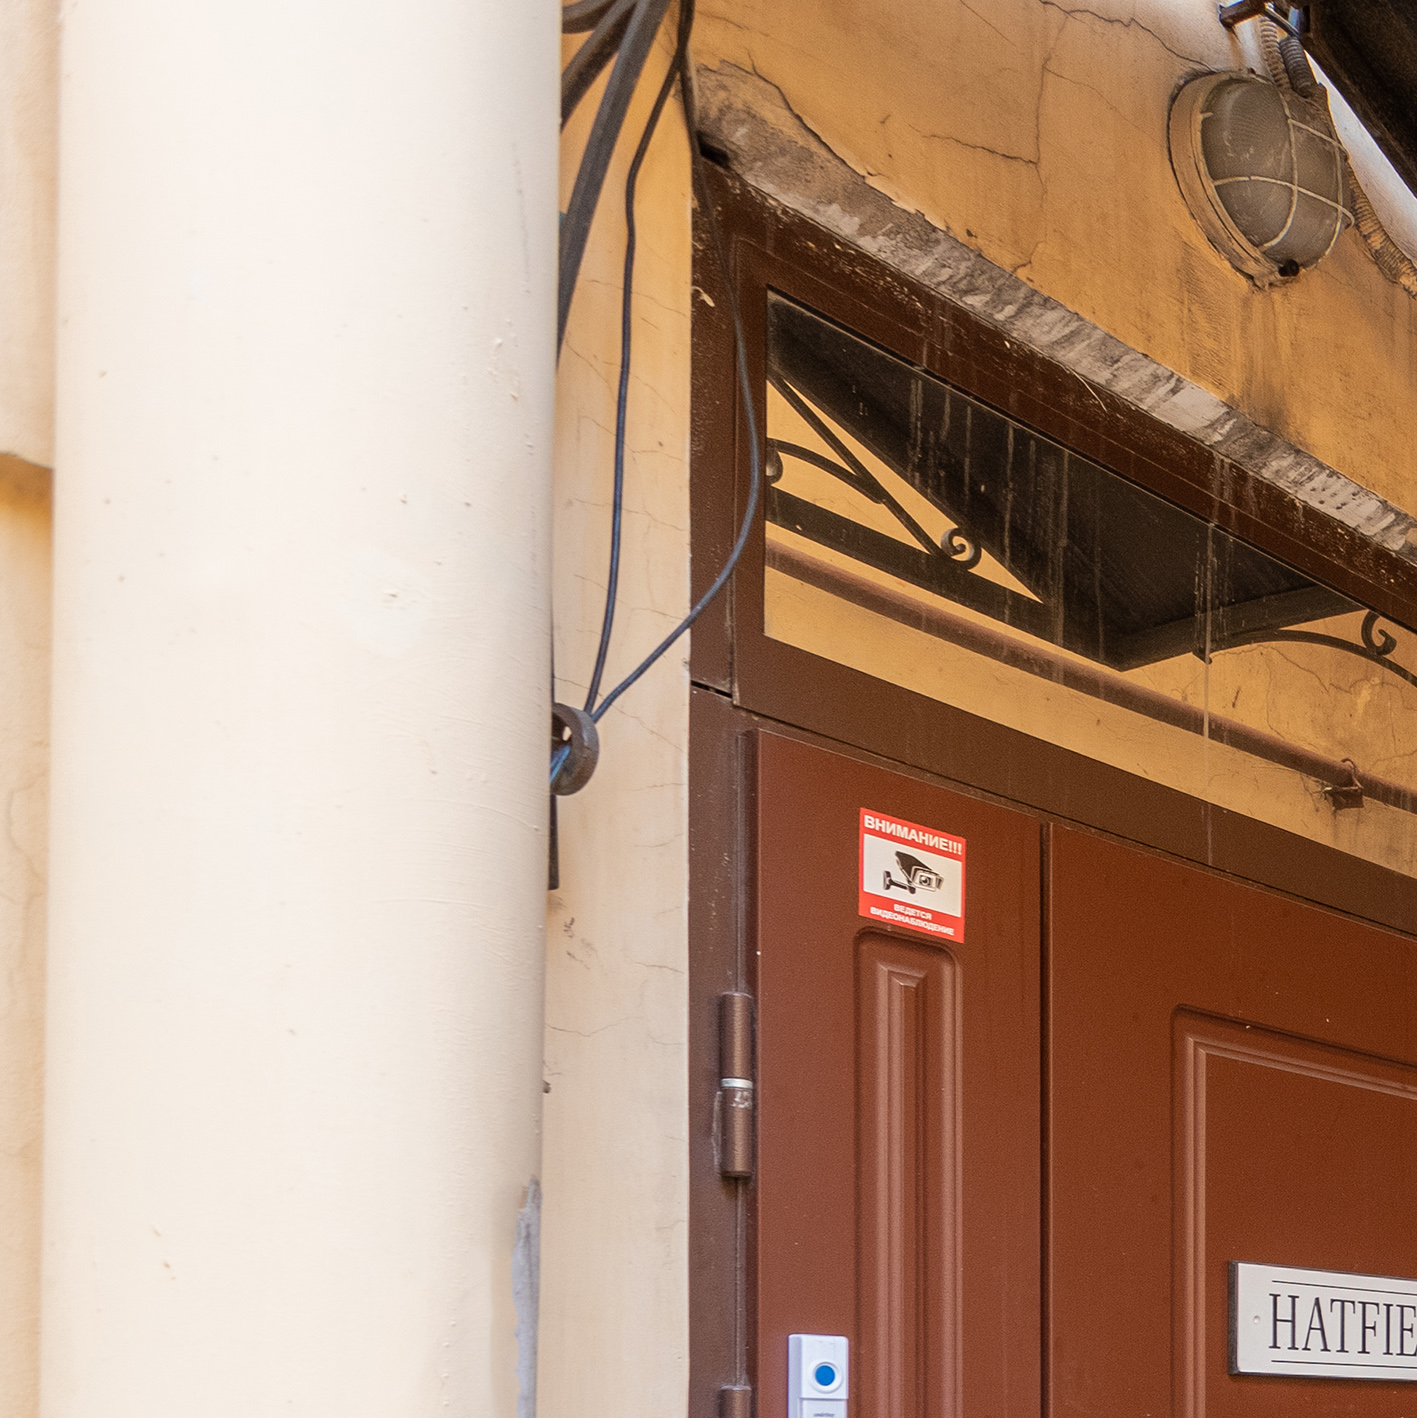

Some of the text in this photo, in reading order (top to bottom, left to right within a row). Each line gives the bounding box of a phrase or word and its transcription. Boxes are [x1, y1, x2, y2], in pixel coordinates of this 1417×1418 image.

[863, 814, 962, 855] ВНИМАНИЕ!!!
[870, 906, 955, 936] ВИДЕОНАБЛЮДЕНИЕ
[893, 903, 932, 921] ВЕДЕТСЯ
